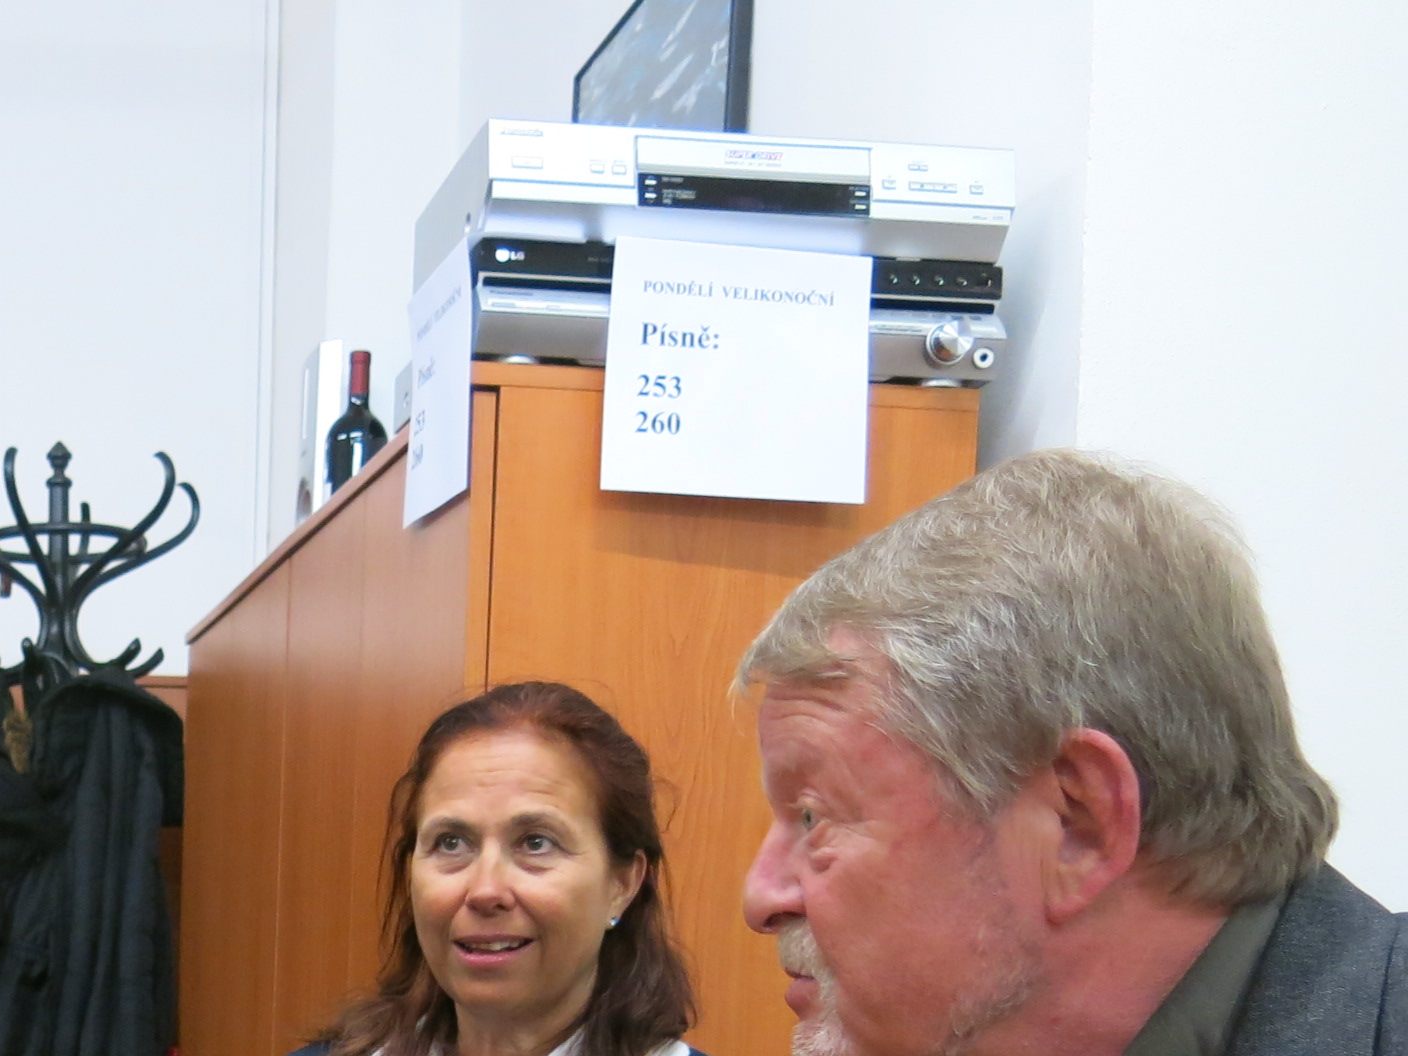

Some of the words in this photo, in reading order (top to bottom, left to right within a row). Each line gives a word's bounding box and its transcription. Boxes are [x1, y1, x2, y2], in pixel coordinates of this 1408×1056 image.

[510, 250, 525, 261] LG
[722, 285, 834, 306] VELIKONOČNÍ
[641, 320, 720, 349] Písně:
[637, 373, 682, 399] 253
[635, 410, 681, 435] 260
